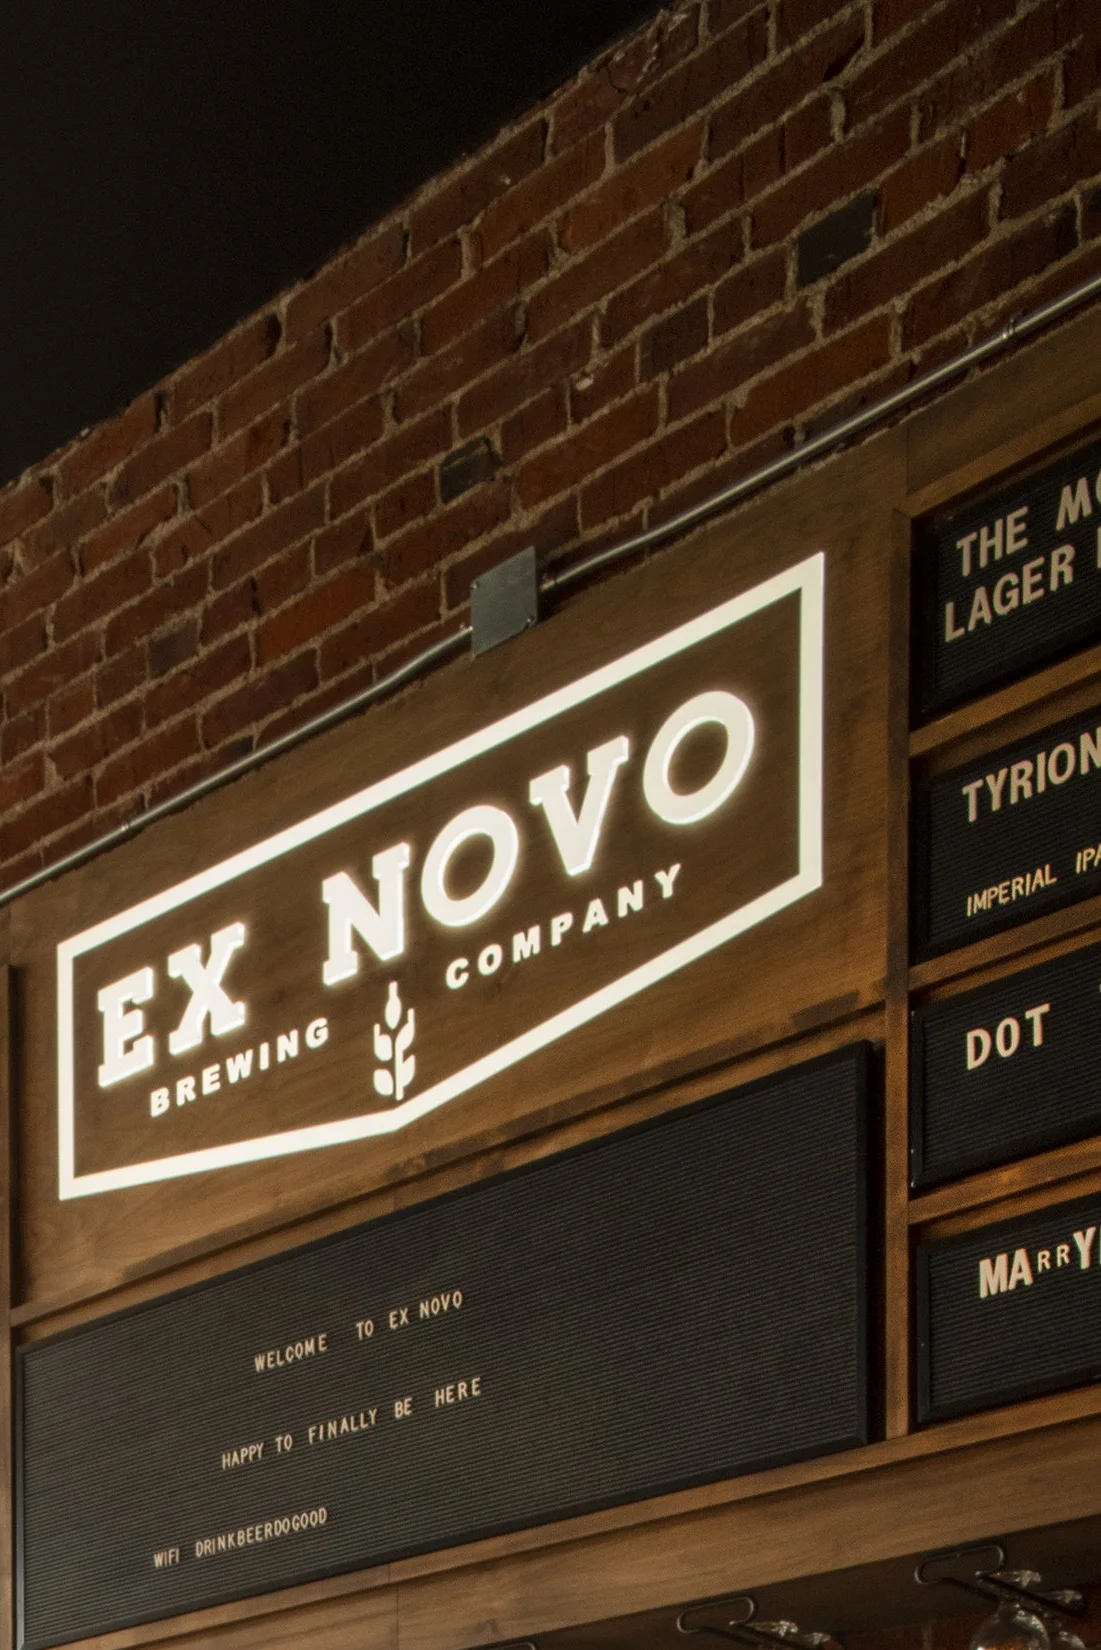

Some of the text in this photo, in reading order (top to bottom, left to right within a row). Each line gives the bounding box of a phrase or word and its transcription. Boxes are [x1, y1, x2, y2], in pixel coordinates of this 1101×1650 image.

[956, 506, 1029, 577] THE
[1054, 467, 1101, 532] M
[943, 542, 1076, 643] LAGER
[98, 690, 755, 1088] EX NOVO
[965, 863, 1058, 918] IMPERIAL
[150, 863, 682, 1117] BREWING COMPANY
[966, 1002, 1051, 1071] DOT
[253, 1290, 464, 1373] WELCOME TO EX NOVO
[220, 1376, 482, 1471] HAPPY TO FINALLY BE HERE
[153, 1506, 329, 1569] WIFI DRINKBEERDOGOOD
